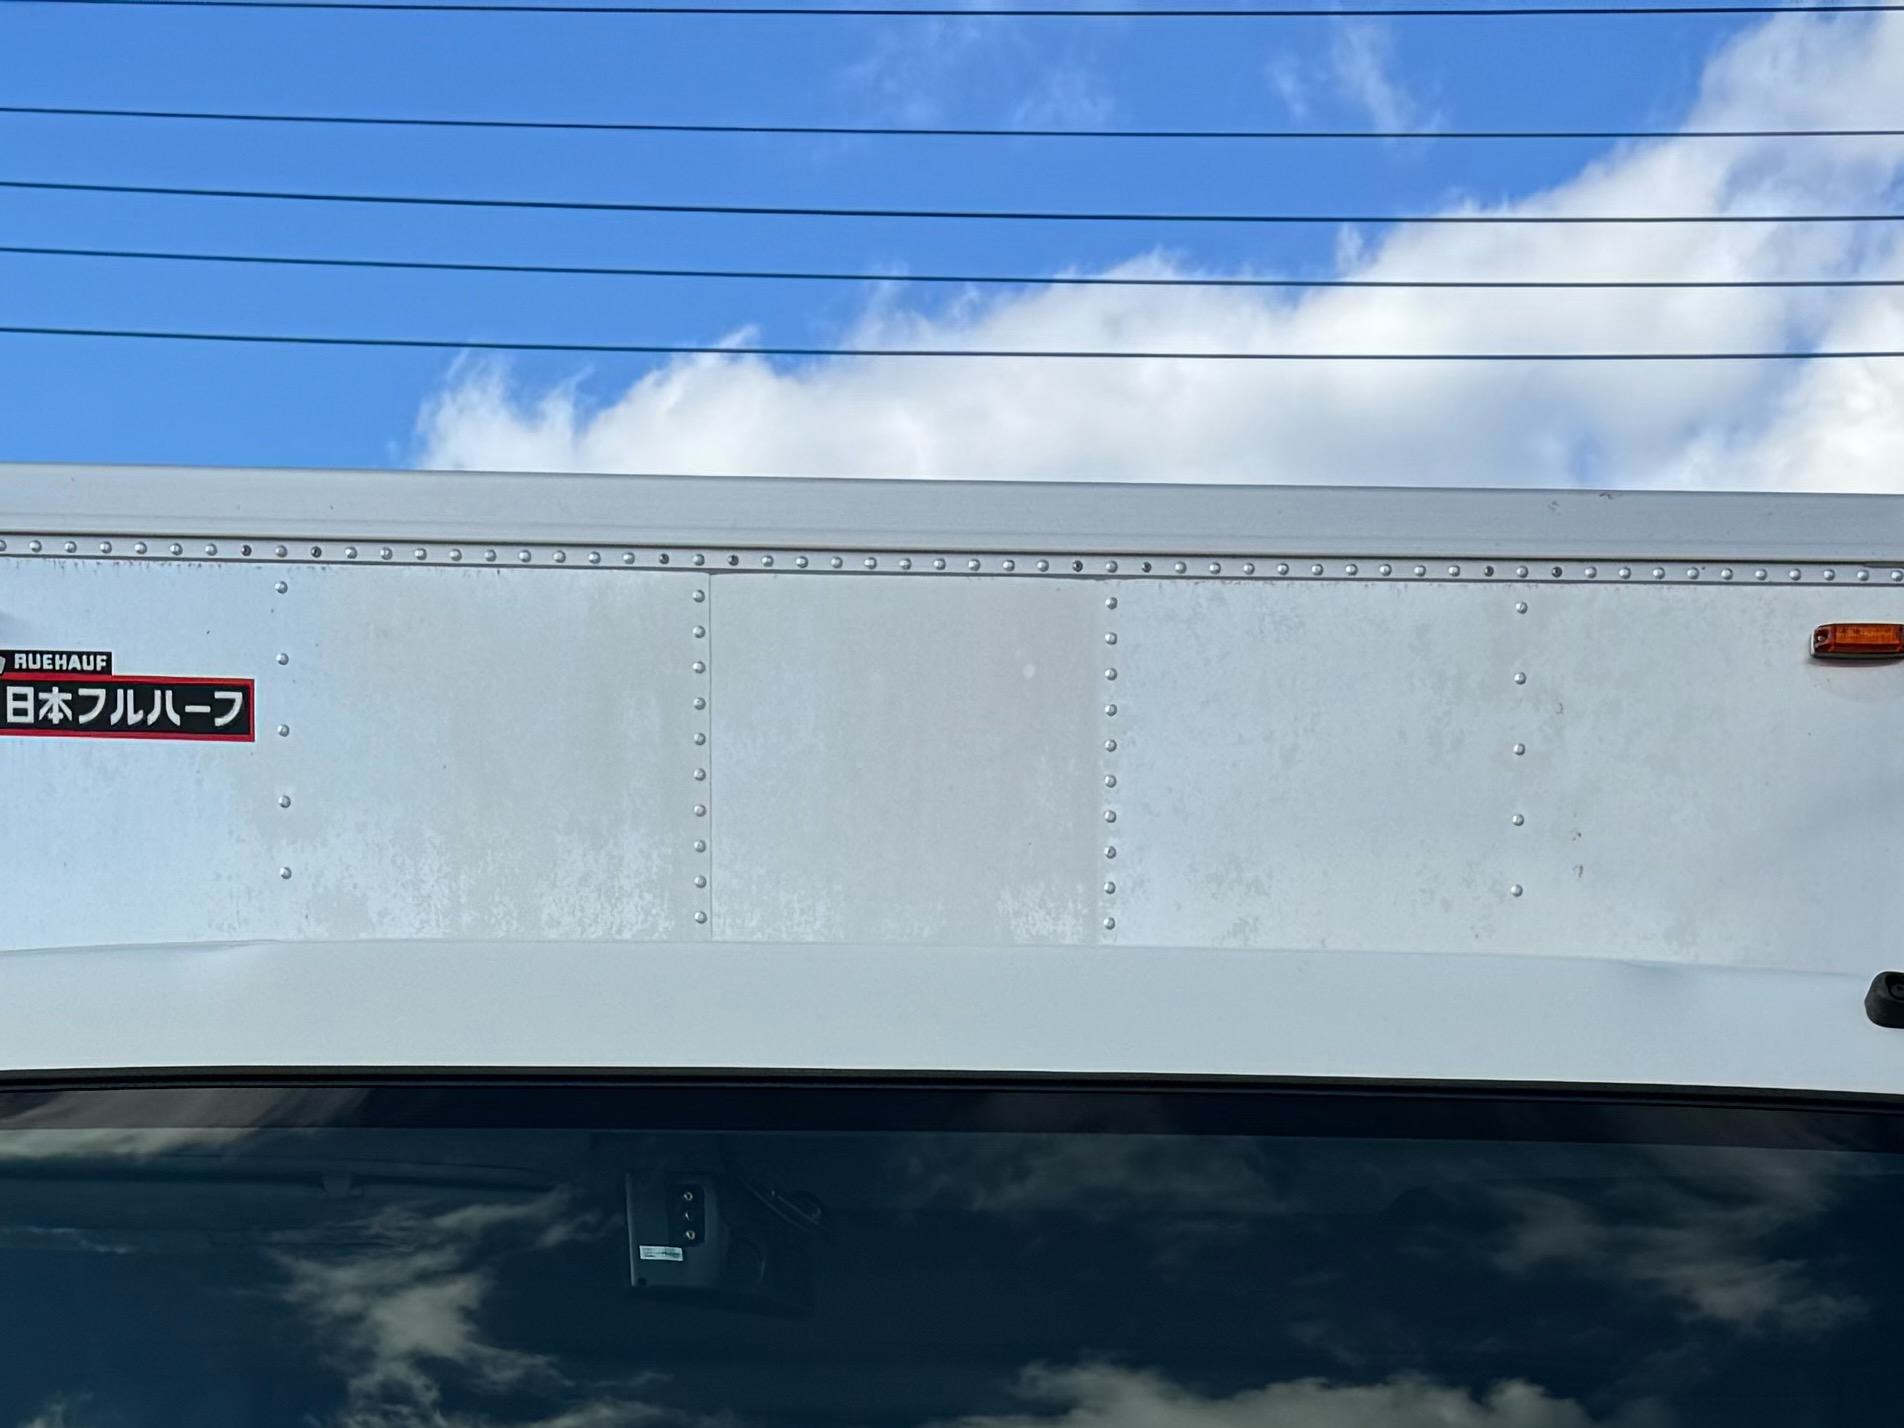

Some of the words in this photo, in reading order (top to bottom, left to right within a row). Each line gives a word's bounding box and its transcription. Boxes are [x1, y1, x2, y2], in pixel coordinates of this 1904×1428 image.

[6, 685, 244, 727] 日本フルハーフ
